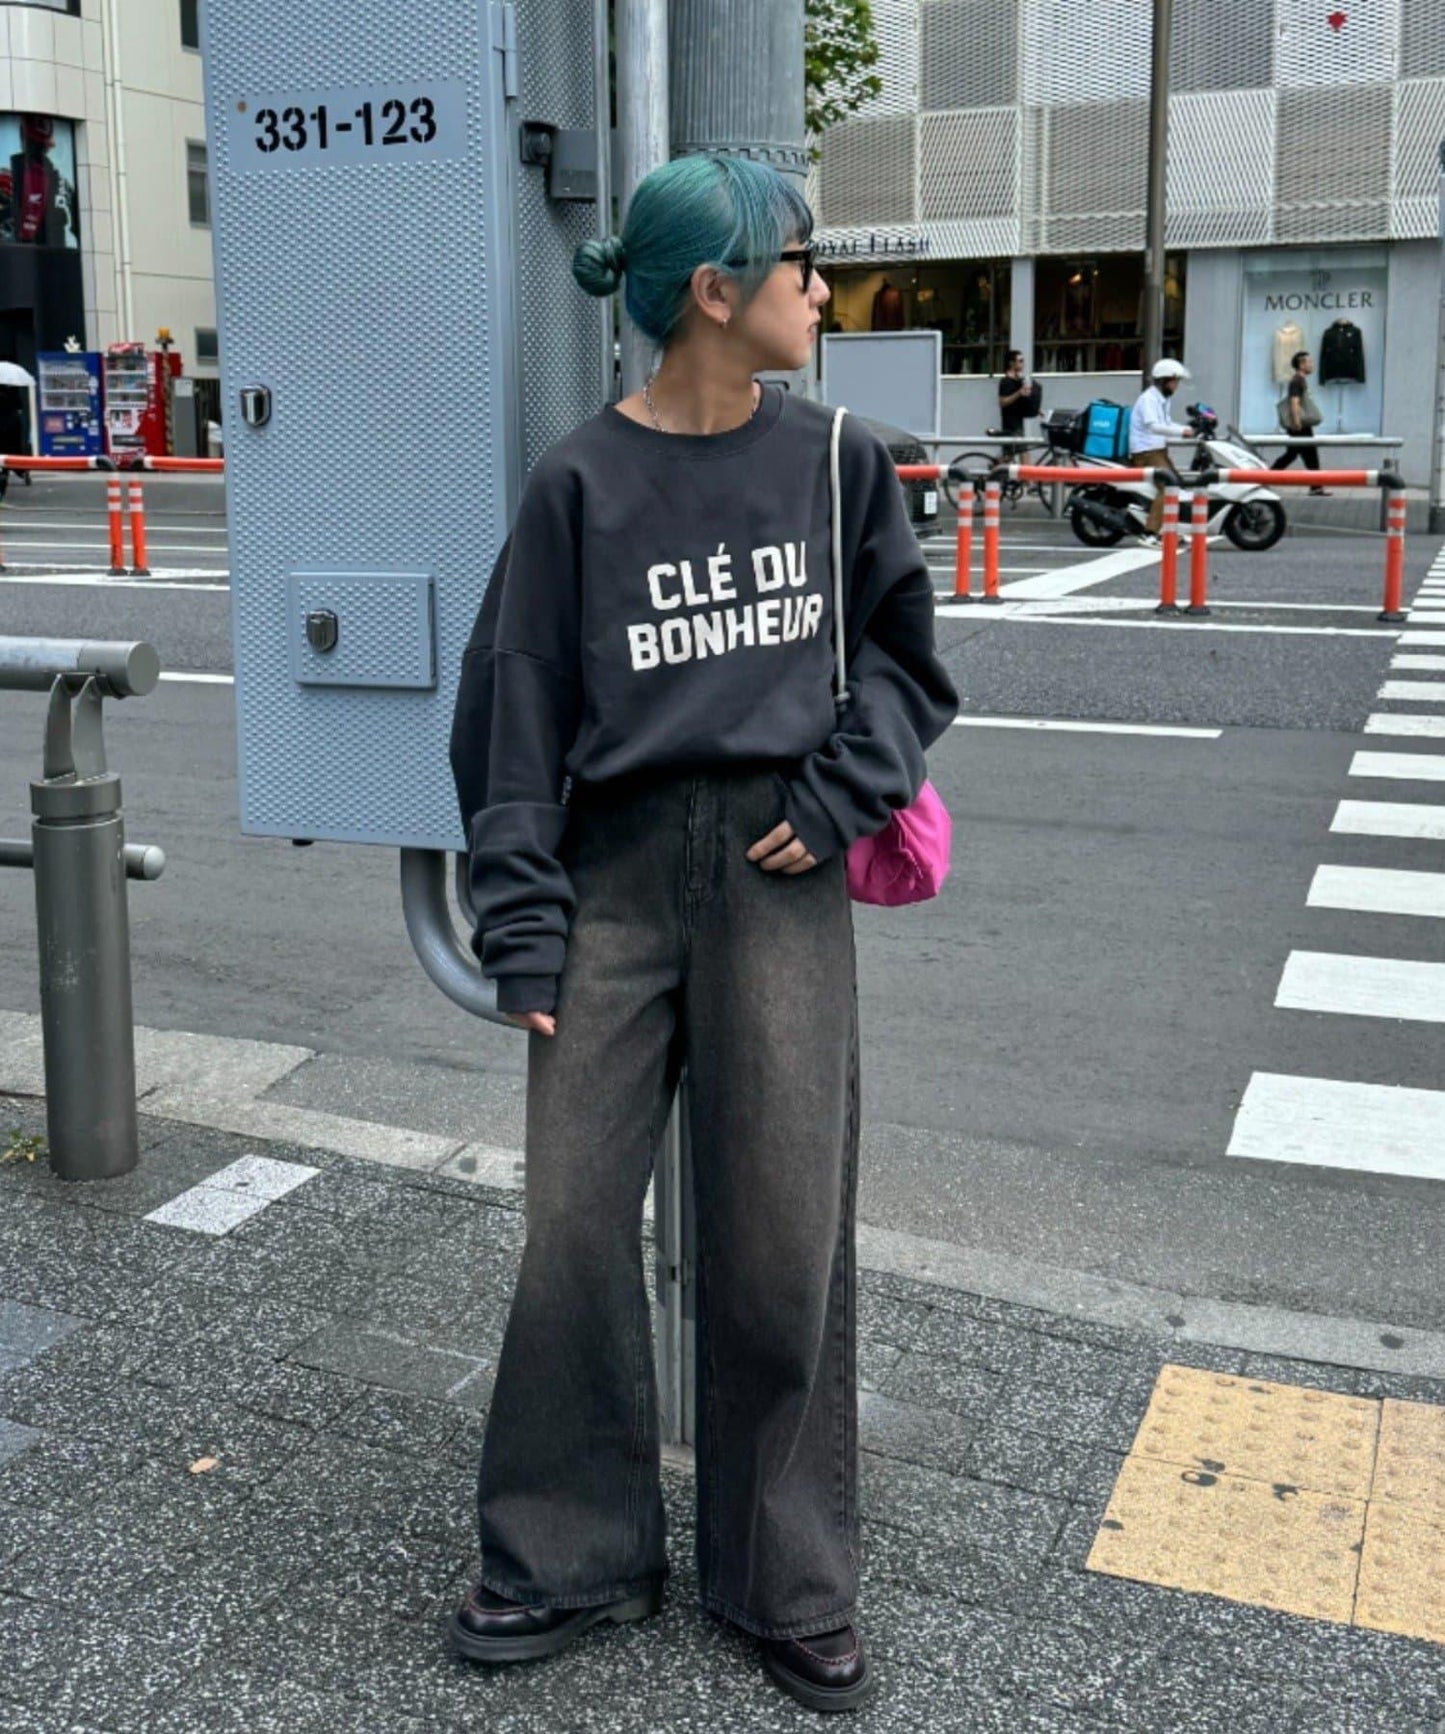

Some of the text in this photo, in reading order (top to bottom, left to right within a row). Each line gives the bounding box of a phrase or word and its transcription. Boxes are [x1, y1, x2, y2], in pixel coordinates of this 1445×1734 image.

[255, 97, 437, 153] 331-123
[1264, 291, 1374, 311] MONCLER
[647, 541, 808, 610] CLÉ DU
[627, 593, 824, 671] BONHEUR
